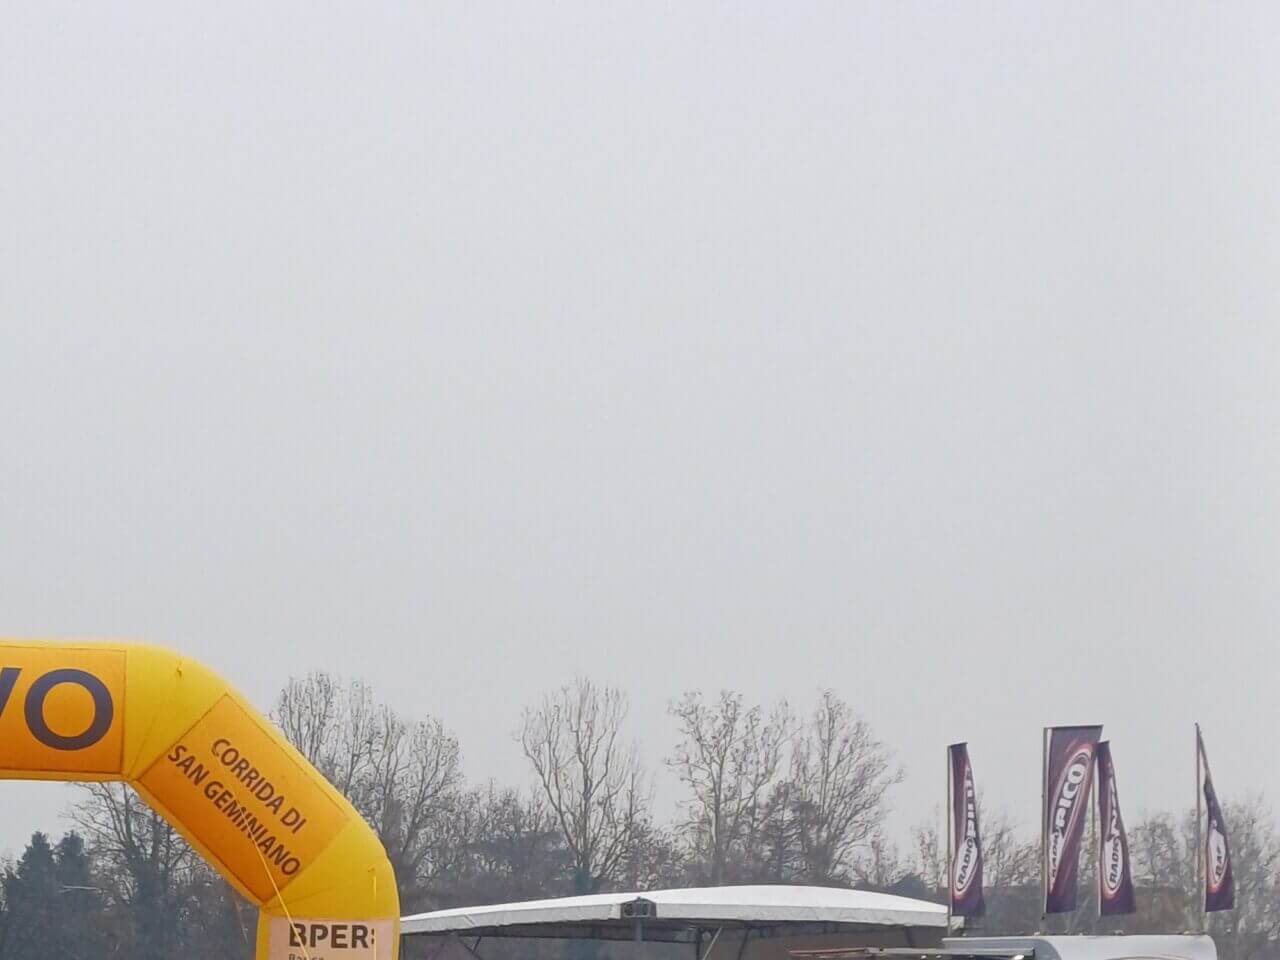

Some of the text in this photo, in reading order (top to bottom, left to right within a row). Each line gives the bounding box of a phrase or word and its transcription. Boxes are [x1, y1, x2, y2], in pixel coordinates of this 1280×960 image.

[167, 745, 301, 876] SAN GEMINIANO
[211, 738, 307, 834] CORRIDA DI
[1056, 763, 1087, 829] PICO
[288, 922, 376, 949] BPER:
